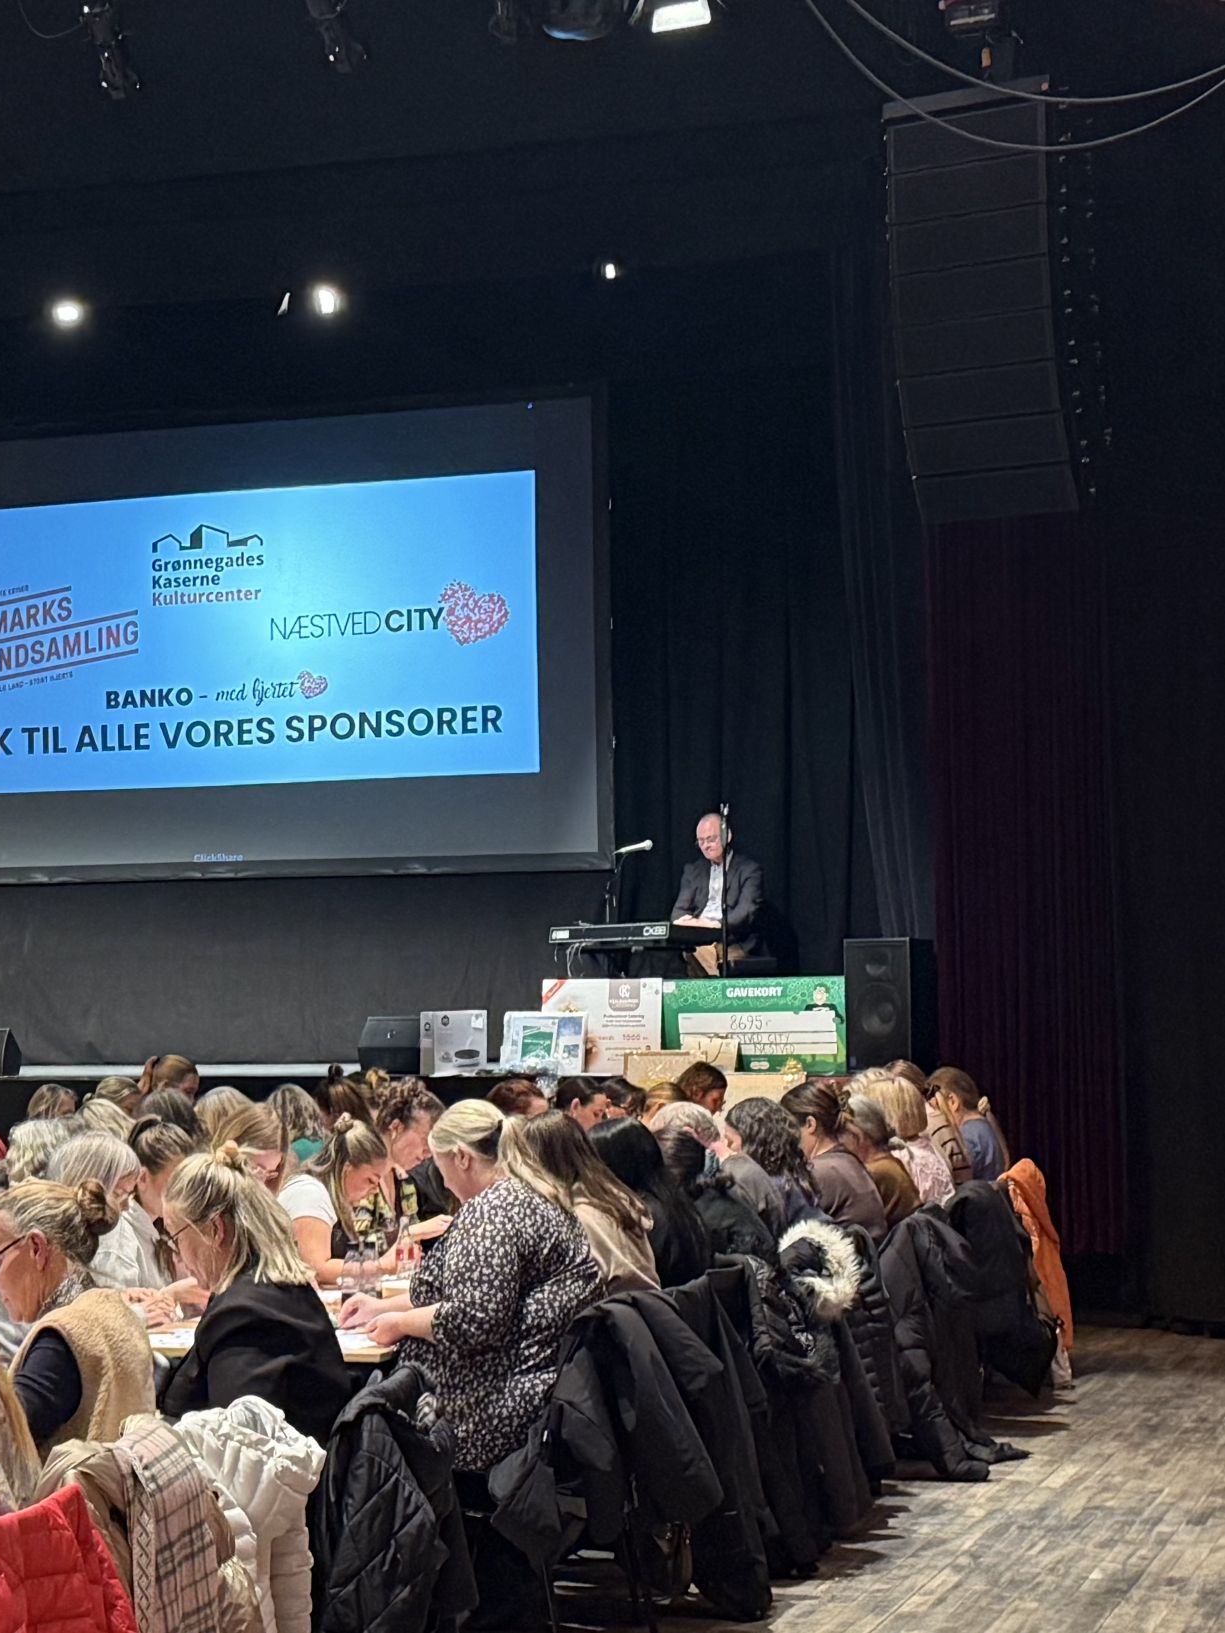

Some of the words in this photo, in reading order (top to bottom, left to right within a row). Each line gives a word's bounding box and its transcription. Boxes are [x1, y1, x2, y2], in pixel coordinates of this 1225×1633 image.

[151, 551, 264, 573] Grønnegades
[152, 573, 221, 590] Kaserne
[152, 588, 262, 607] Kulturcenter
[270, 610, 382, 641] NÆSTVED
[384, 606, 445, 633] CITY
[105, 686, 193, 710] BANKO
[215, 682, 247, 702] med
[252, 677, 299, 707] hjertet
[21, 725, 67, 755] TIL
[75, 723, 150, 753] ALLE
[159, 716, 276, 750] VORES
[285, 704, 503, 743] SPONSORER
[726, 986, 783, 998] GAVEKORT
